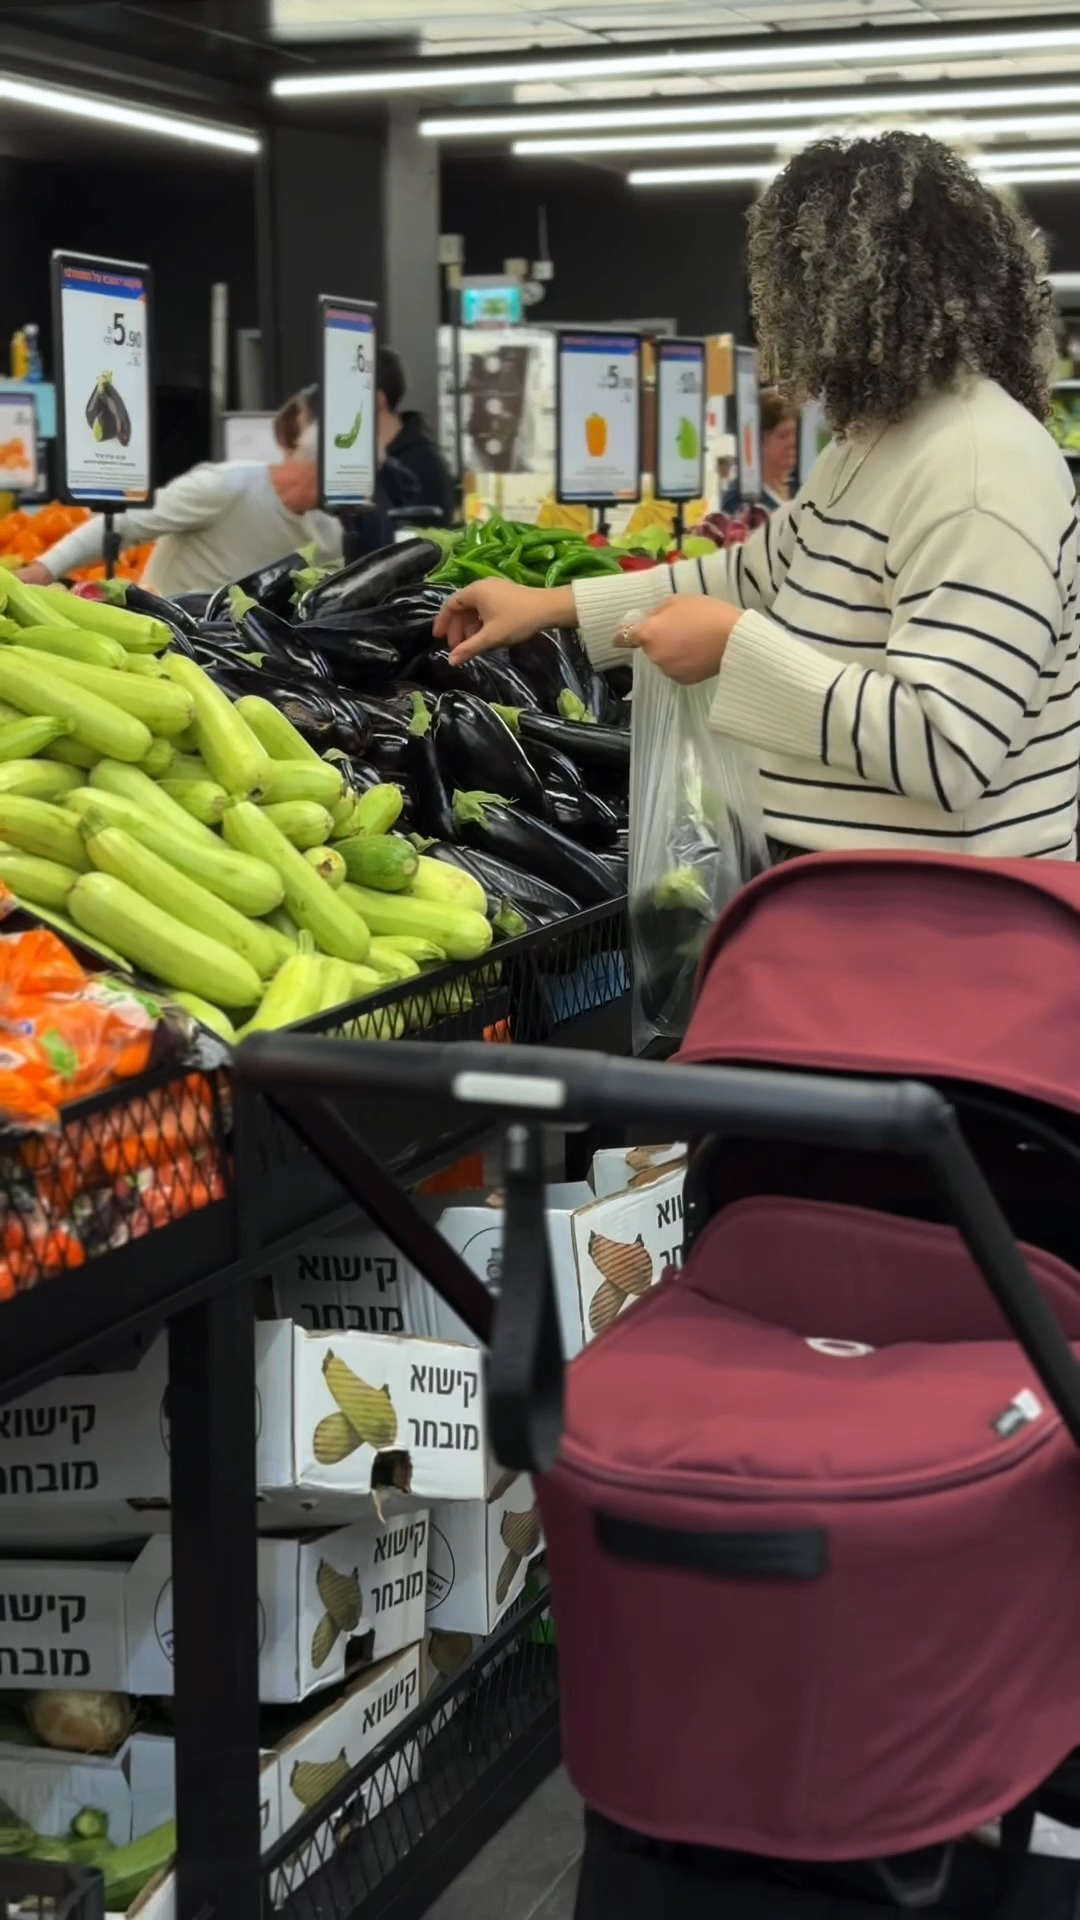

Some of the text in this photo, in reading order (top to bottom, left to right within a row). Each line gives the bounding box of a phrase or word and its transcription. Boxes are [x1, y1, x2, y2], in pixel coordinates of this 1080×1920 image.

[296, 1255, 398, 1292] קישוא
[300, 1304, 404, 1331] מובחר
[410, 1364, 478, 1408] קישוא
[408, 1418, 479, 1450] מובחר
[373, 1521, 426, 1564] קישוא
[371, 1570, 423, 1614] מובחר
[362, 1668, 417, 1735] קישוא
